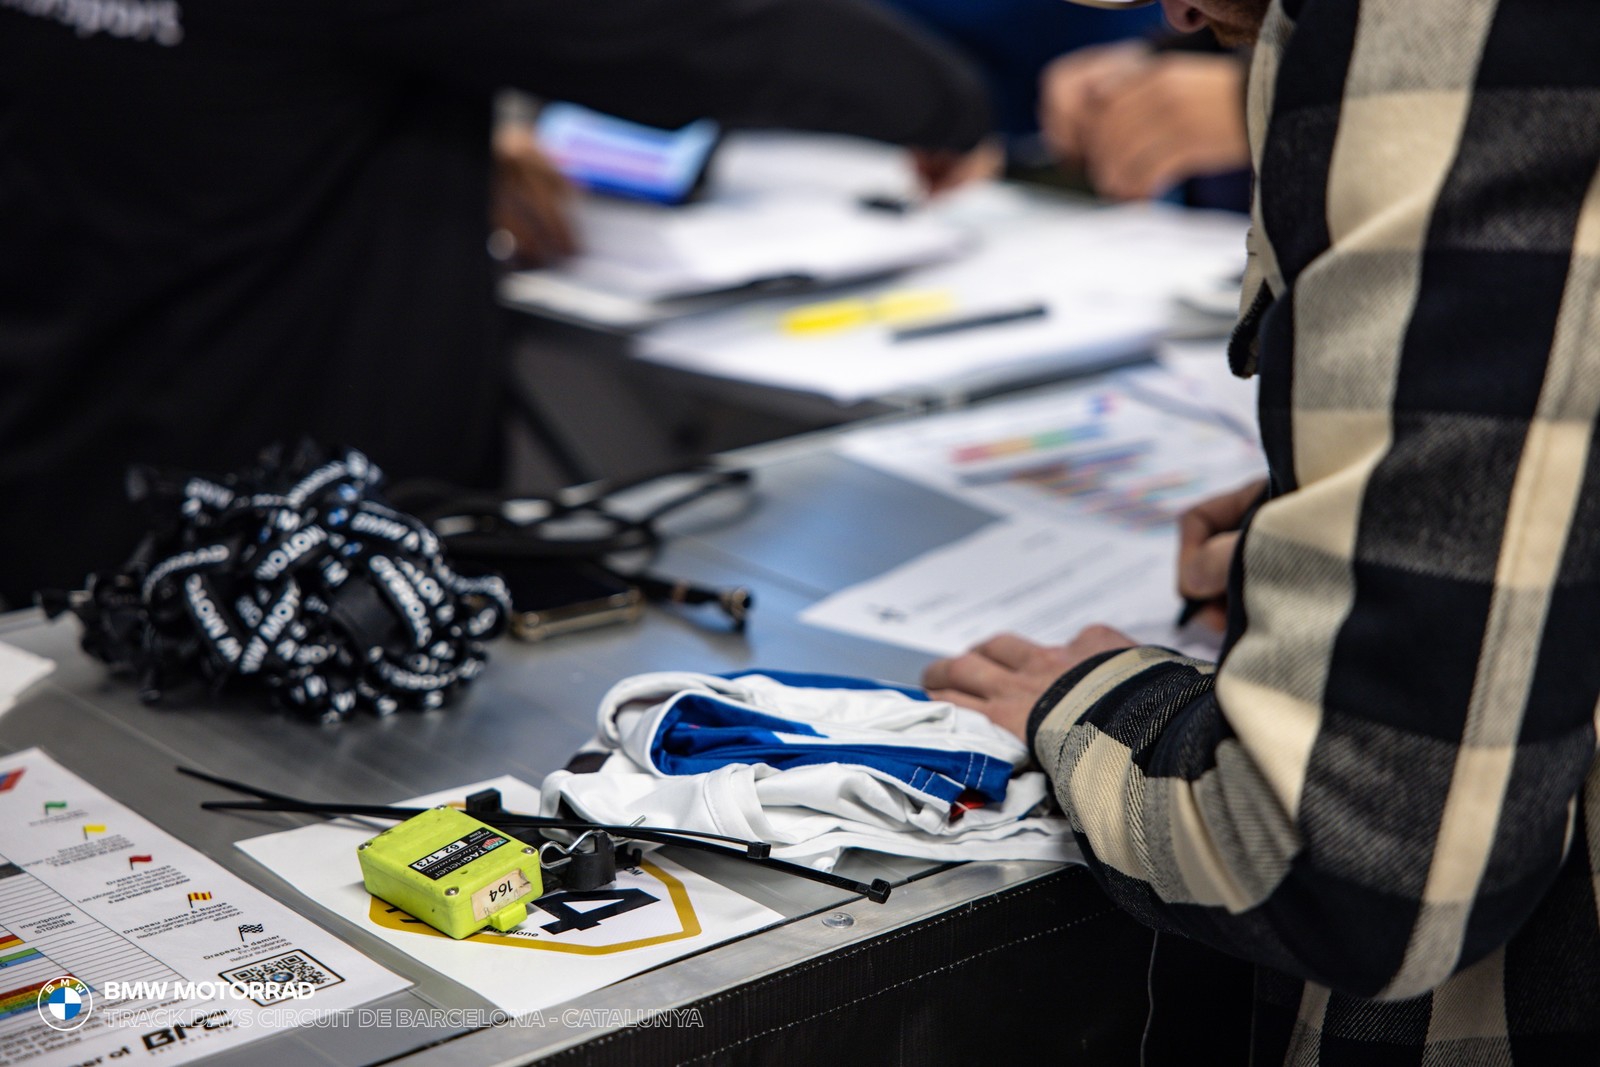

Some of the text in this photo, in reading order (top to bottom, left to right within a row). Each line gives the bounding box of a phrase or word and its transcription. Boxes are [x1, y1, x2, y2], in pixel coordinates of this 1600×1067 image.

[416, 844, 460, 868] 62 173
[489, 879, 514, 903] 164
